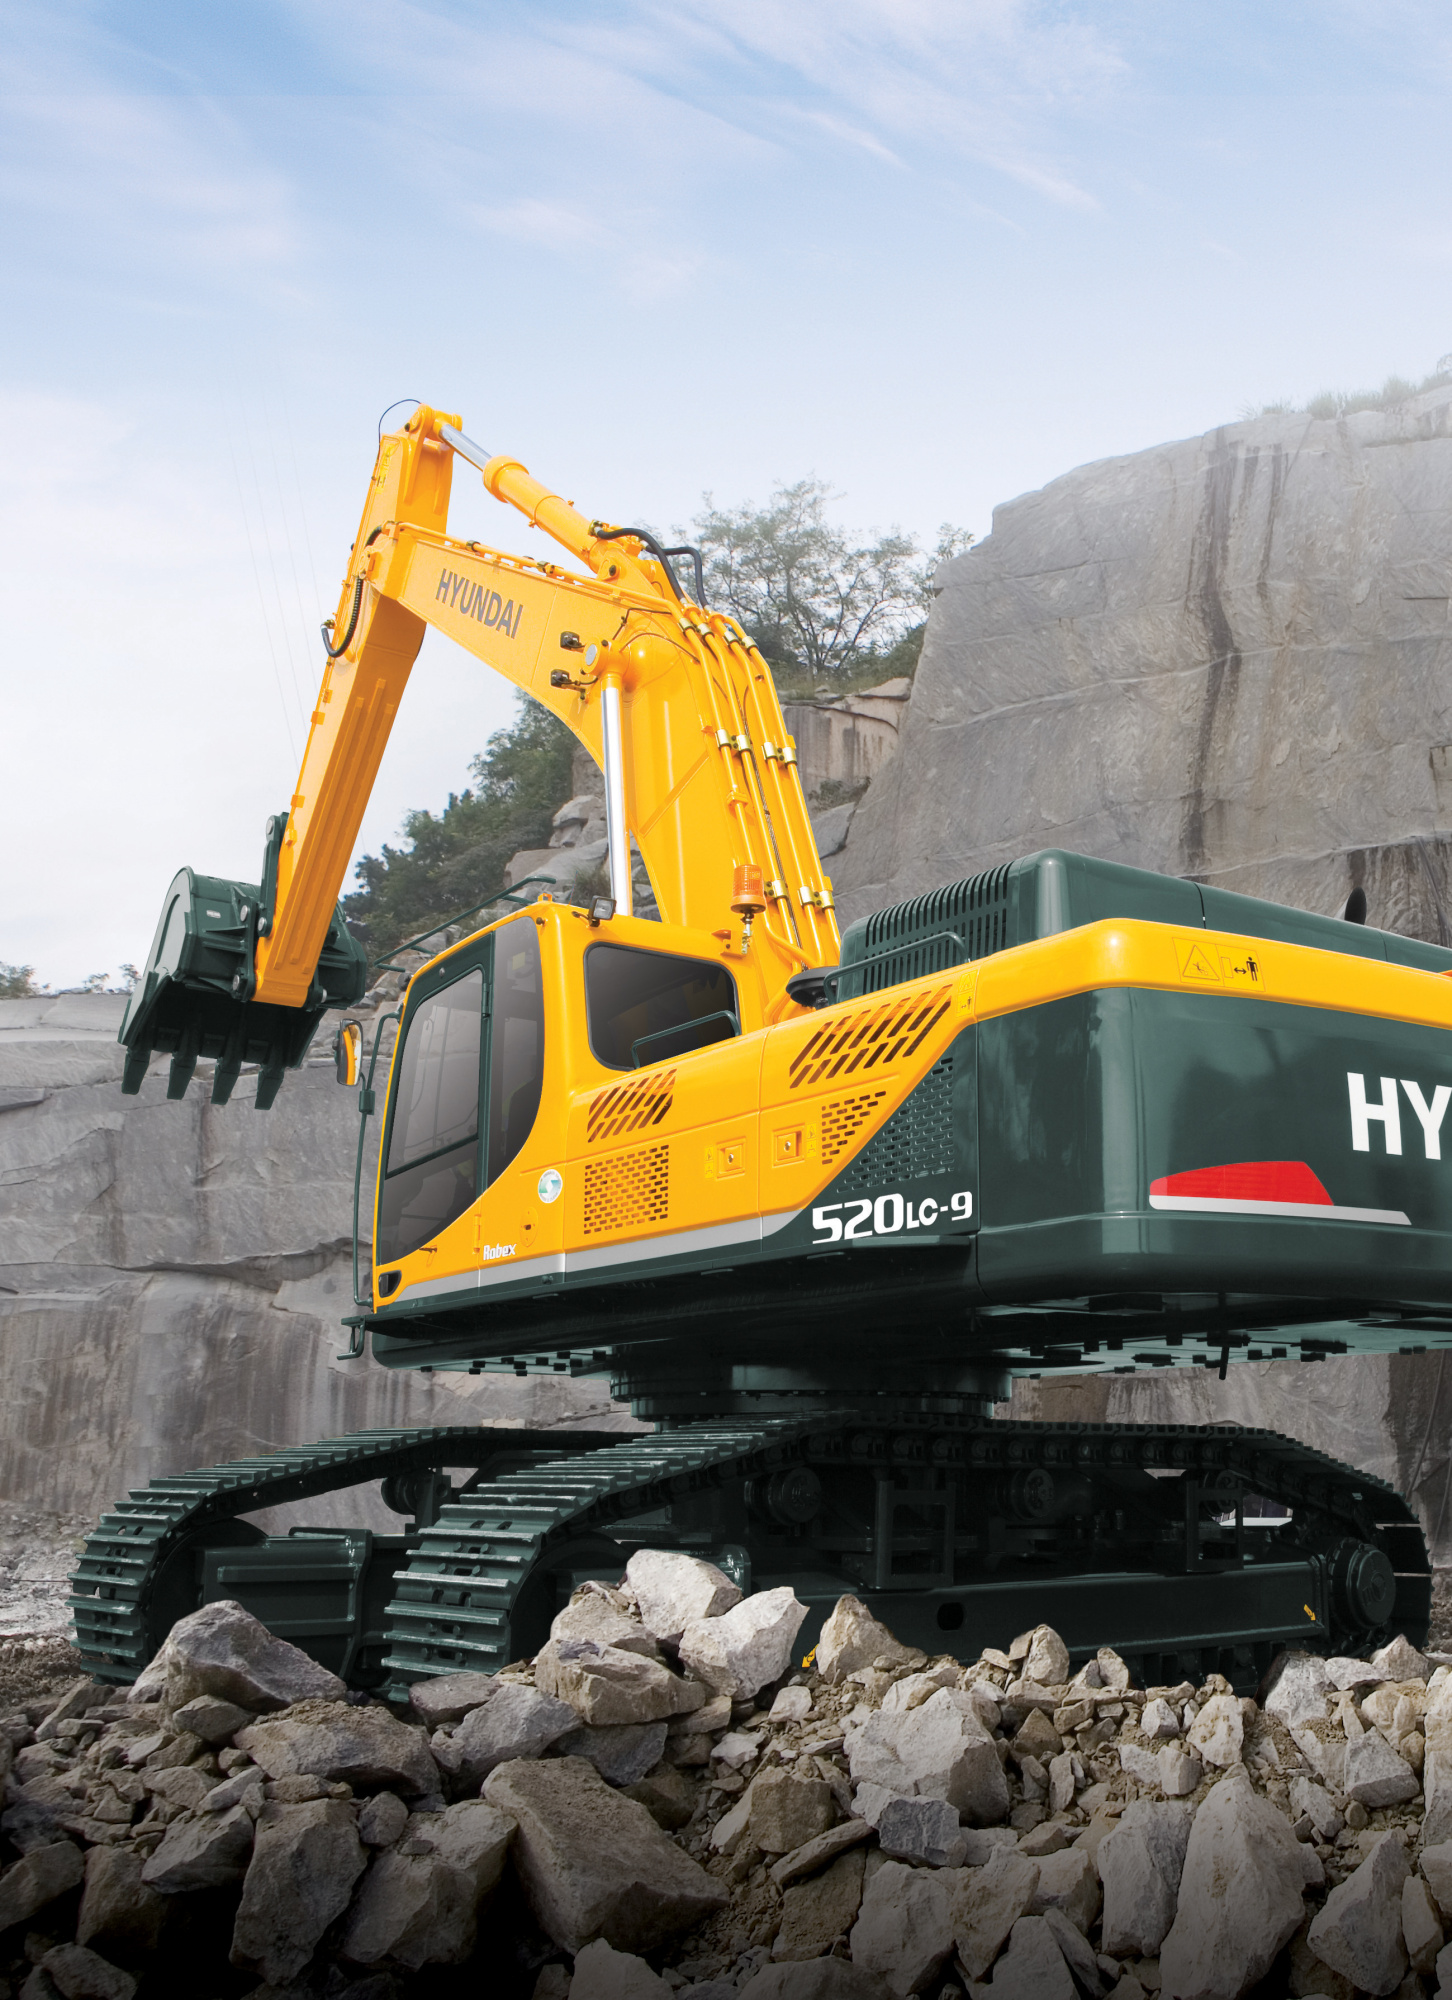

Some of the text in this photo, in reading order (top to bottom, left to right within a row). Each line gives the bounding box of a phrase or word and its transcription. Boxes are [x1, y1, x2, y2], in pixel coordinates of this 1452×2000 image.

[435, 568, 524, 639] HYUNDAI
[1346, 1071, 1452, 1160] HY
[483, 1243, 517, 1260] Robex
